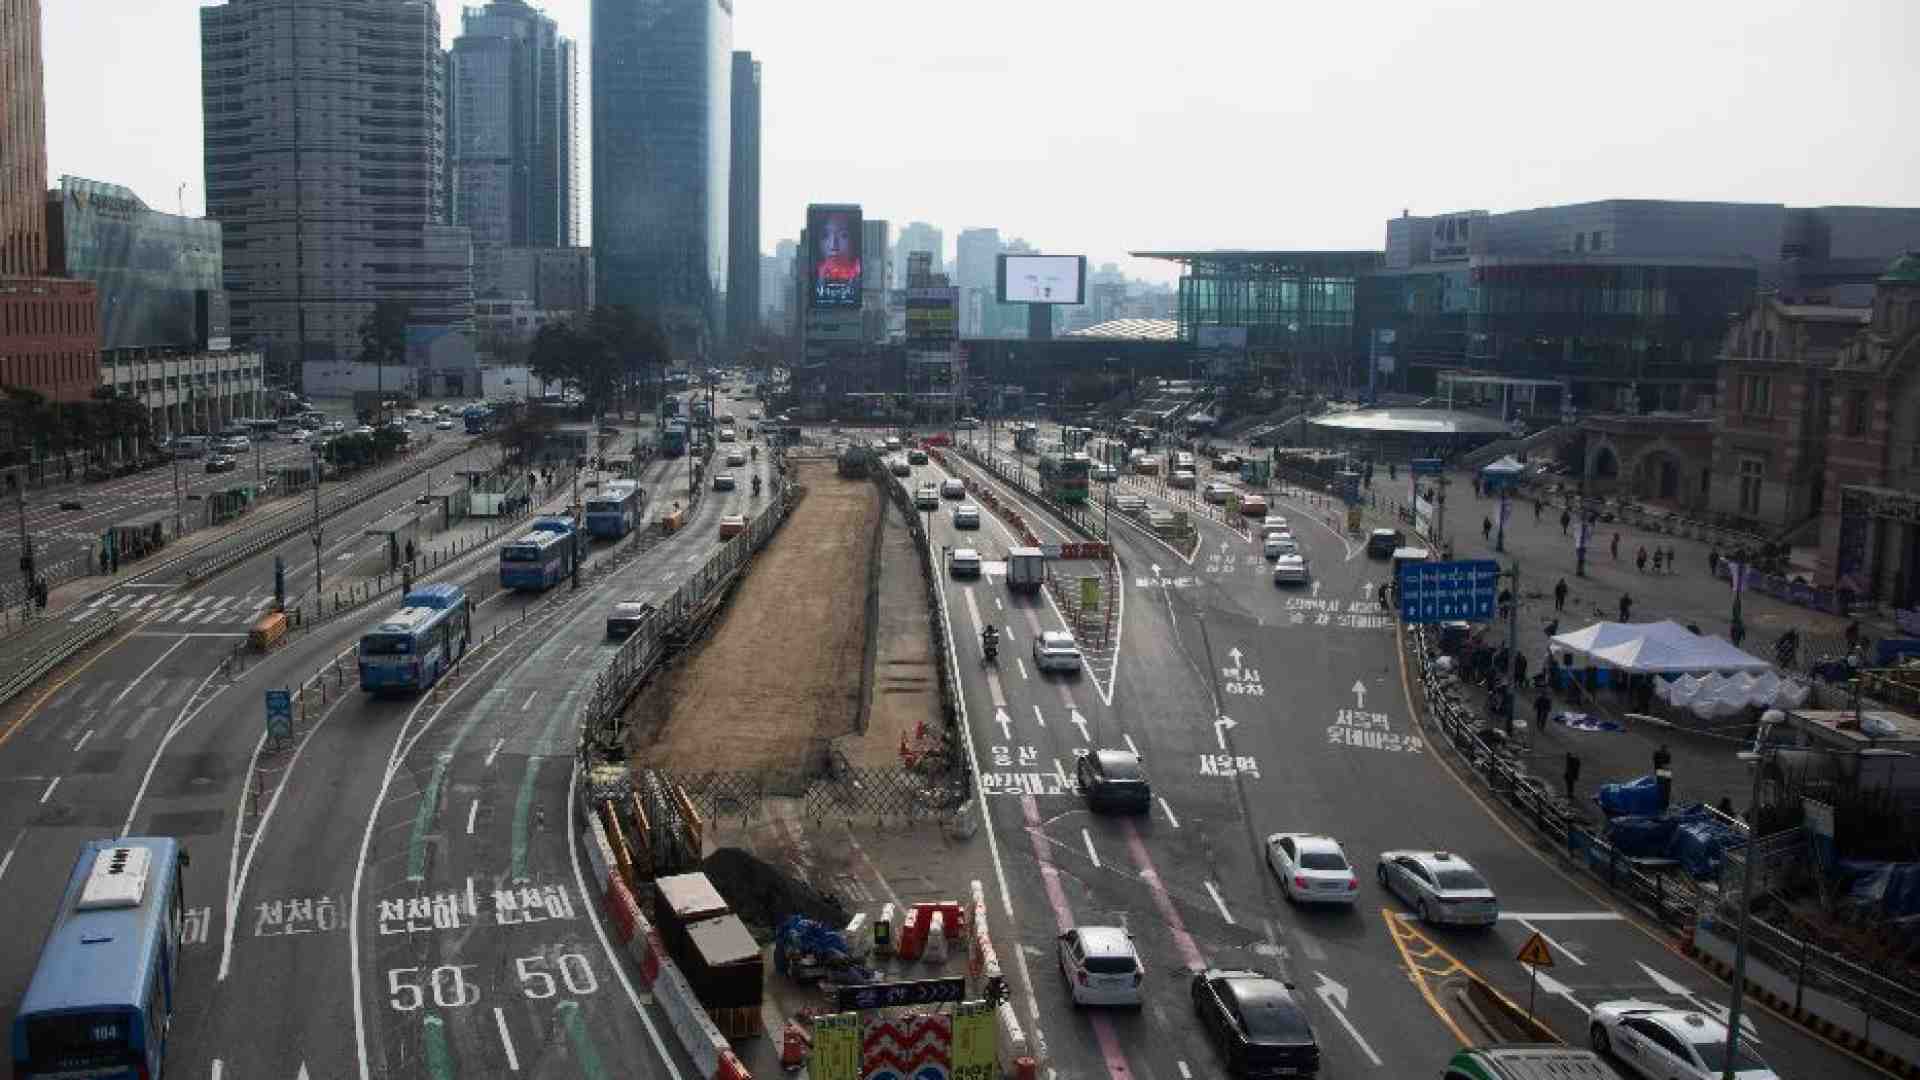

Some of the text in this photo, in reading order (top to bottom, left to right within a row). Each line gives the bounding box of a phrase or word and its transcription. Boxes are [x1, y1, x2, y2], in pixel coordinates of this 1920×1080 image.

[992, 746, 1038, 766] 용산
[1200, 754, 1261, 778] 서울역
[378, 892, 460, 935] 천천히
[493, 884, 575, 925] 천천히
[388, 965, 467, 1011] 50
[516, 954, 599, 999] 50
